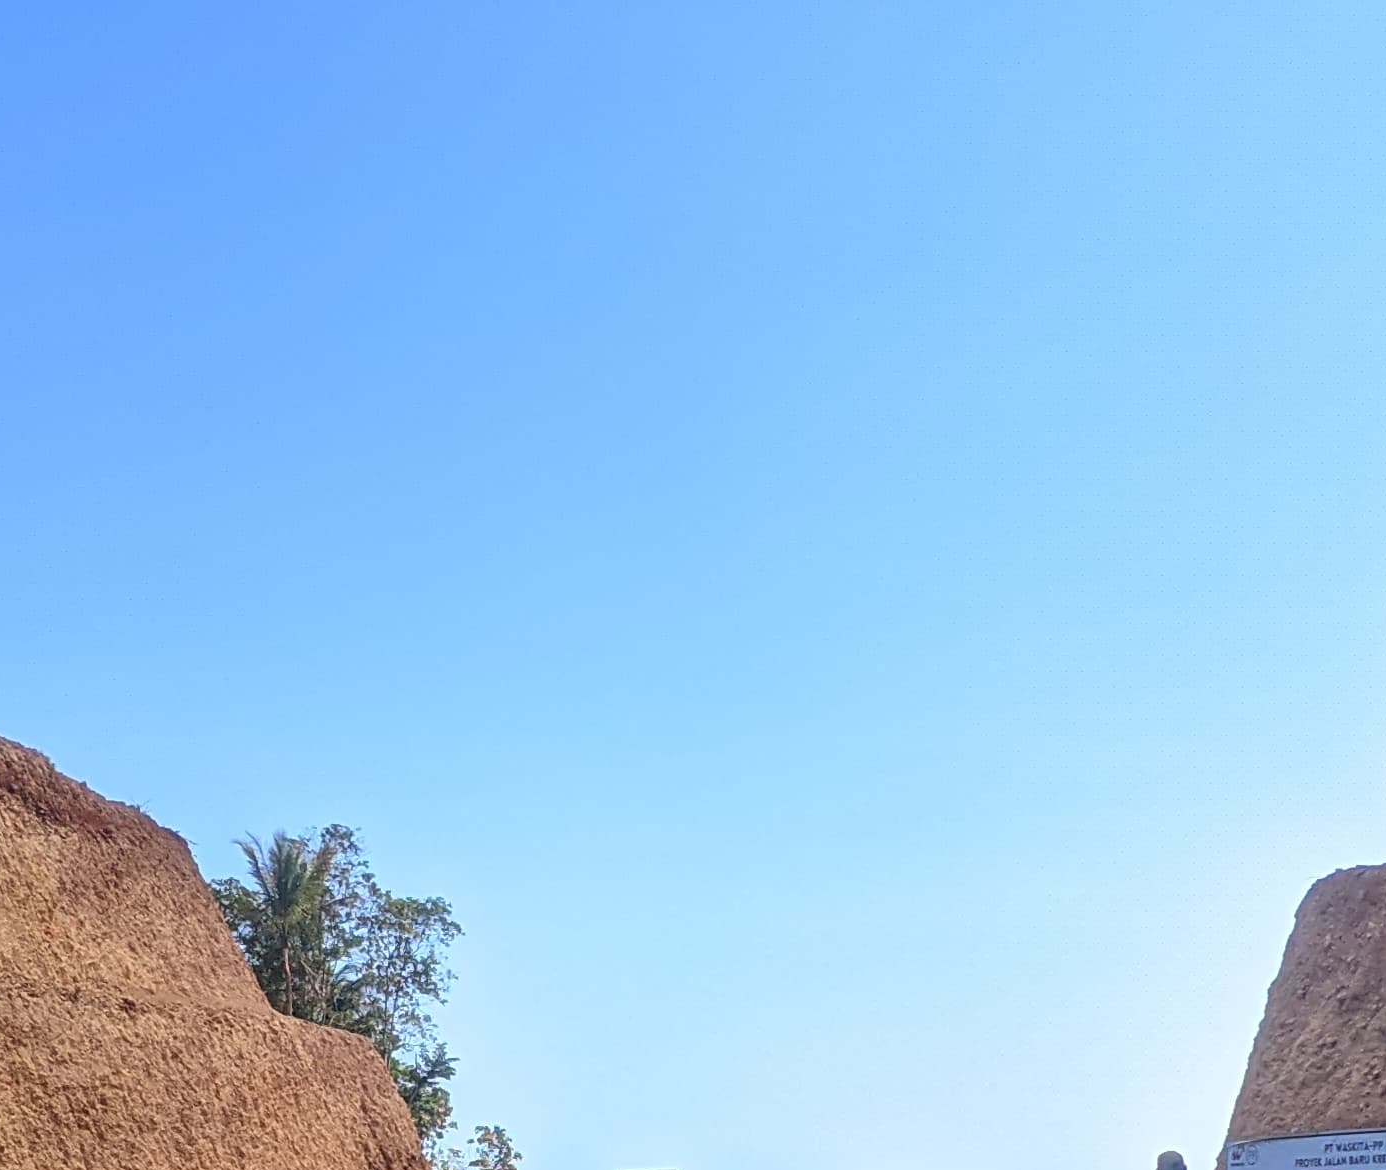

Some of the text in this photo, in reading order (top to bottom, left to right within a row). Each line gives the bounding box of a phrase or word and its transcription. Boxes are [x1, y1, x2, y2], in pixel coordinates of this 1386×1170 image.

[1325, 1143, 1334, 1153] PT
[1295, 1157, 1322, 1167] PROYEK
[1324, 1156, 1346, 1166] JALAN
[1349, 1155, 1369, 1165] BARU
